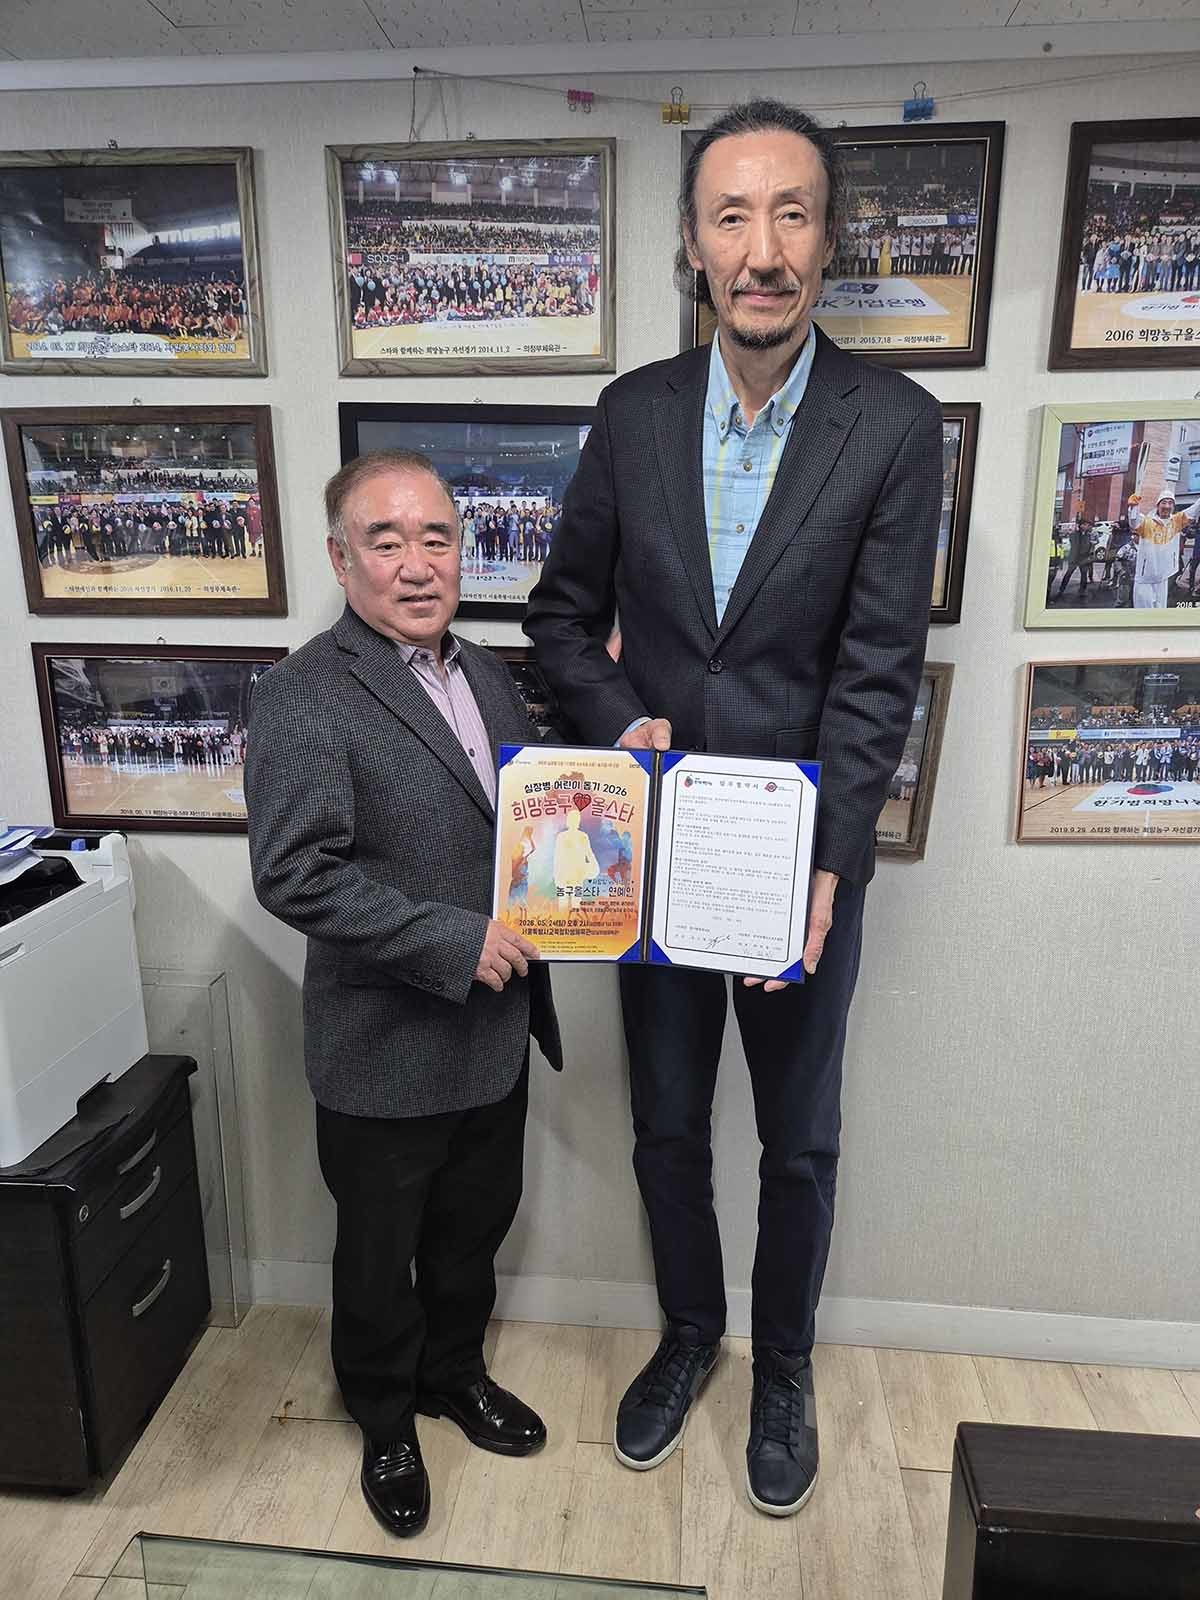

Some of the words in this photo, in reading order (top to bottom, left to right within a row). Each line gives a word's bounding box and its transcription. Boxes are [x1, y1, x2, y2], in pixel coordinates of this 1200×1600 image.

[1105, 329, 1134, 342] 2016
[400, 344, 424, 354] 함께하는
[426, 344, 450, 354] 희망농구
[452, 344, 476, 354] 자선경기
[524, 781, 551, 794] 심장병
[554, 780, 581, 790] 어린이
[602, 783, 628, 797] 2026
[511, 793, 573, 822] 희망농구
[591, 794, 635, 824] 올스타
[556, 885, 600, 898] 농구올스타
[608, 885, 634, 898] 연예인
